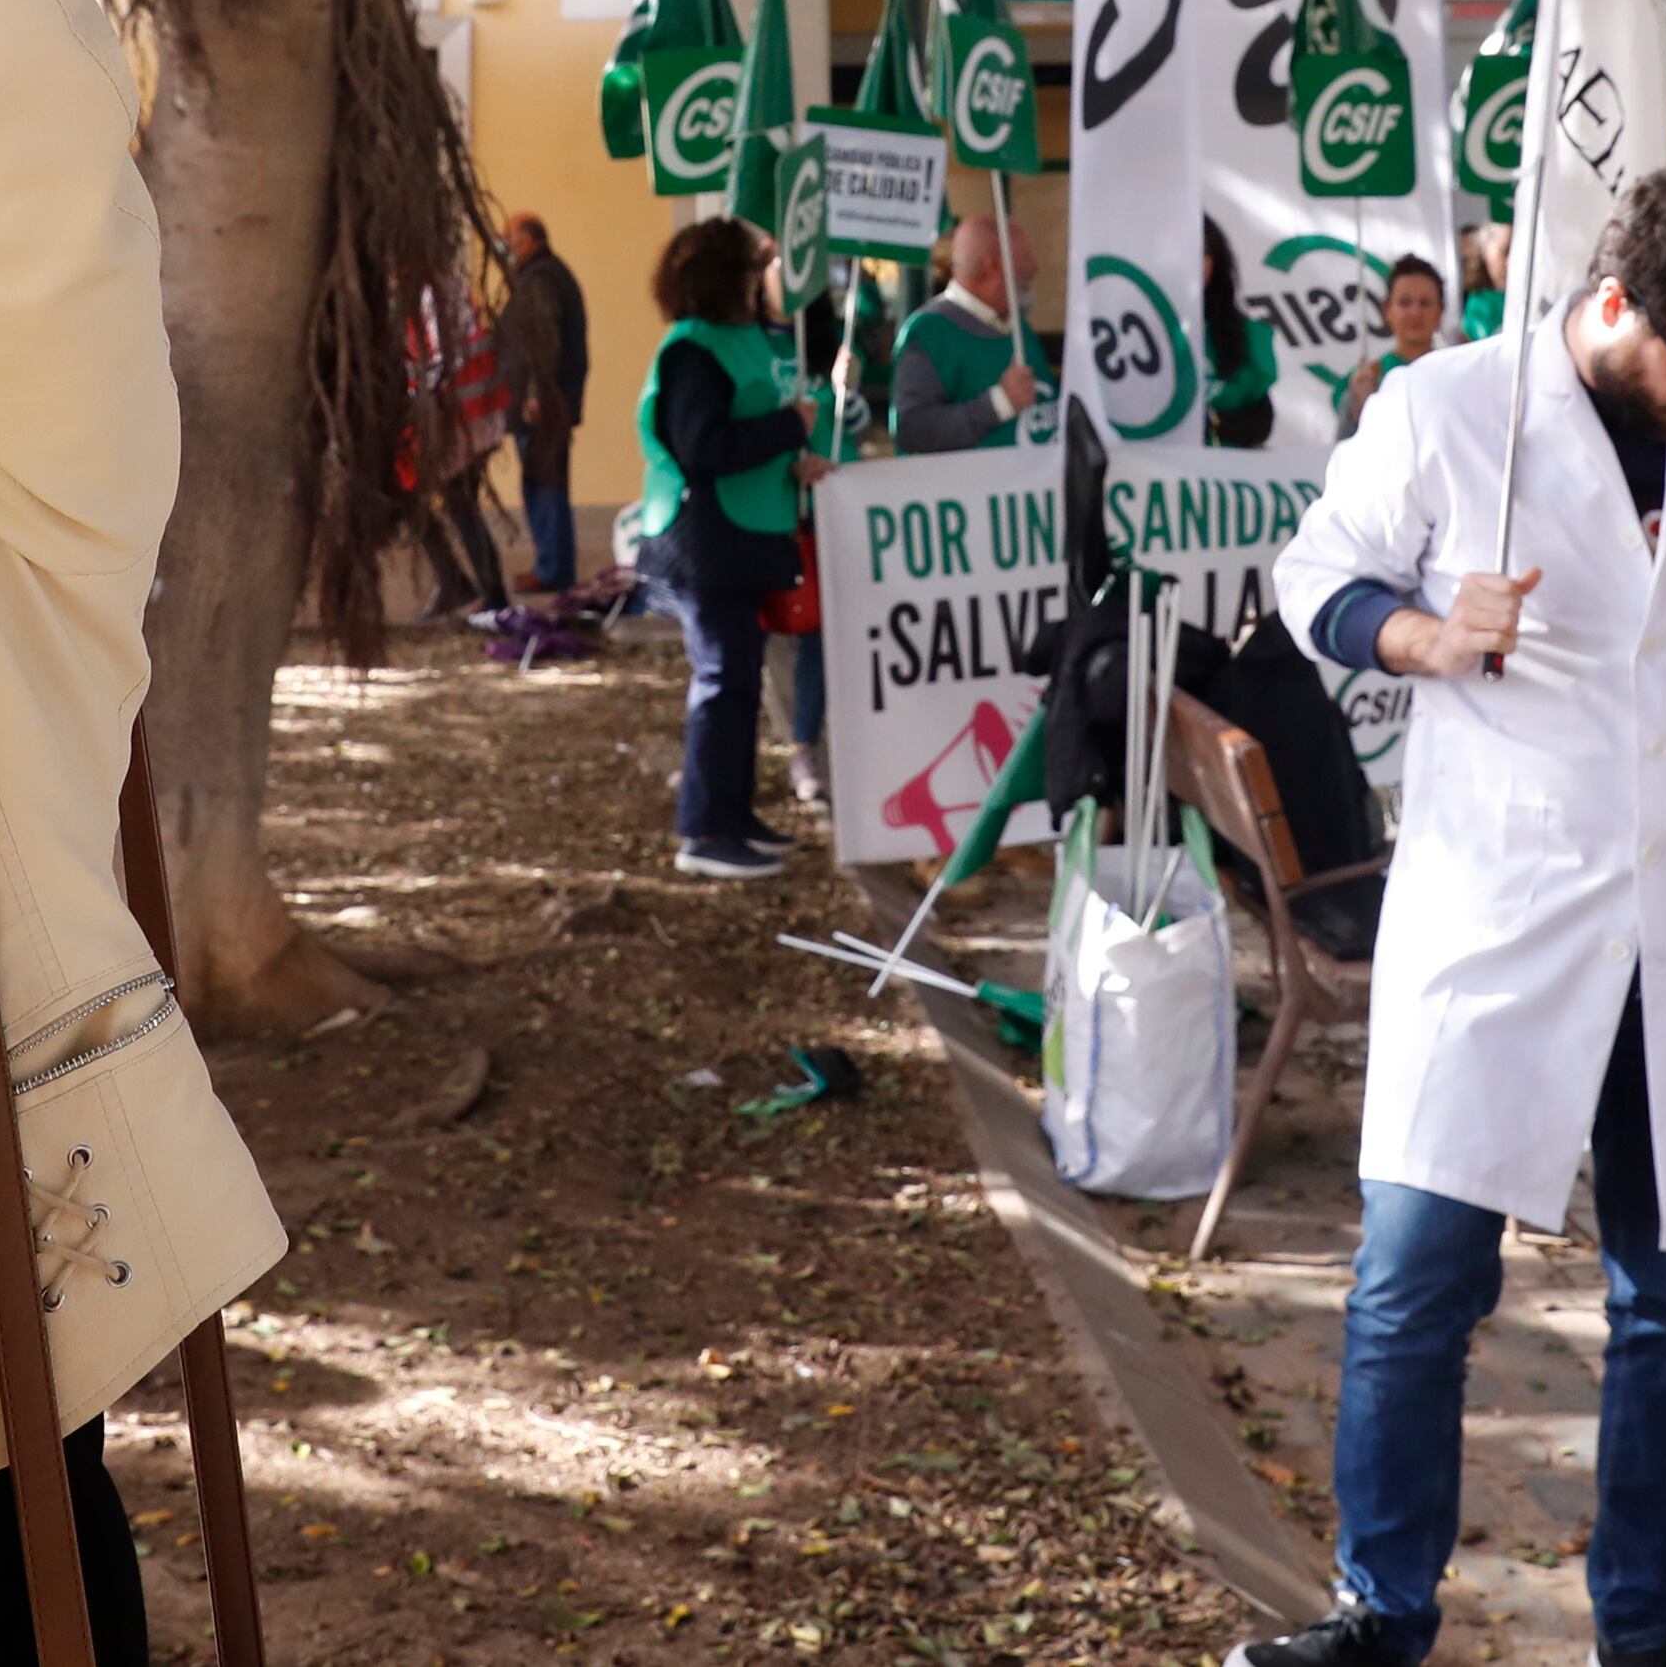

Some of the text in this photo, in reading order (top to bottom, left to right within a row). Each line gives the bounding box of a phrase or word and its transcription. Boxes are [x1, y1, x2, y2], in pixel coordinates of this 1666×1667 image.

[1323, 103, 1403, 145] CSIF
[867, 500, 971, 582] POR
[987, 489, 1070, 571] UN
